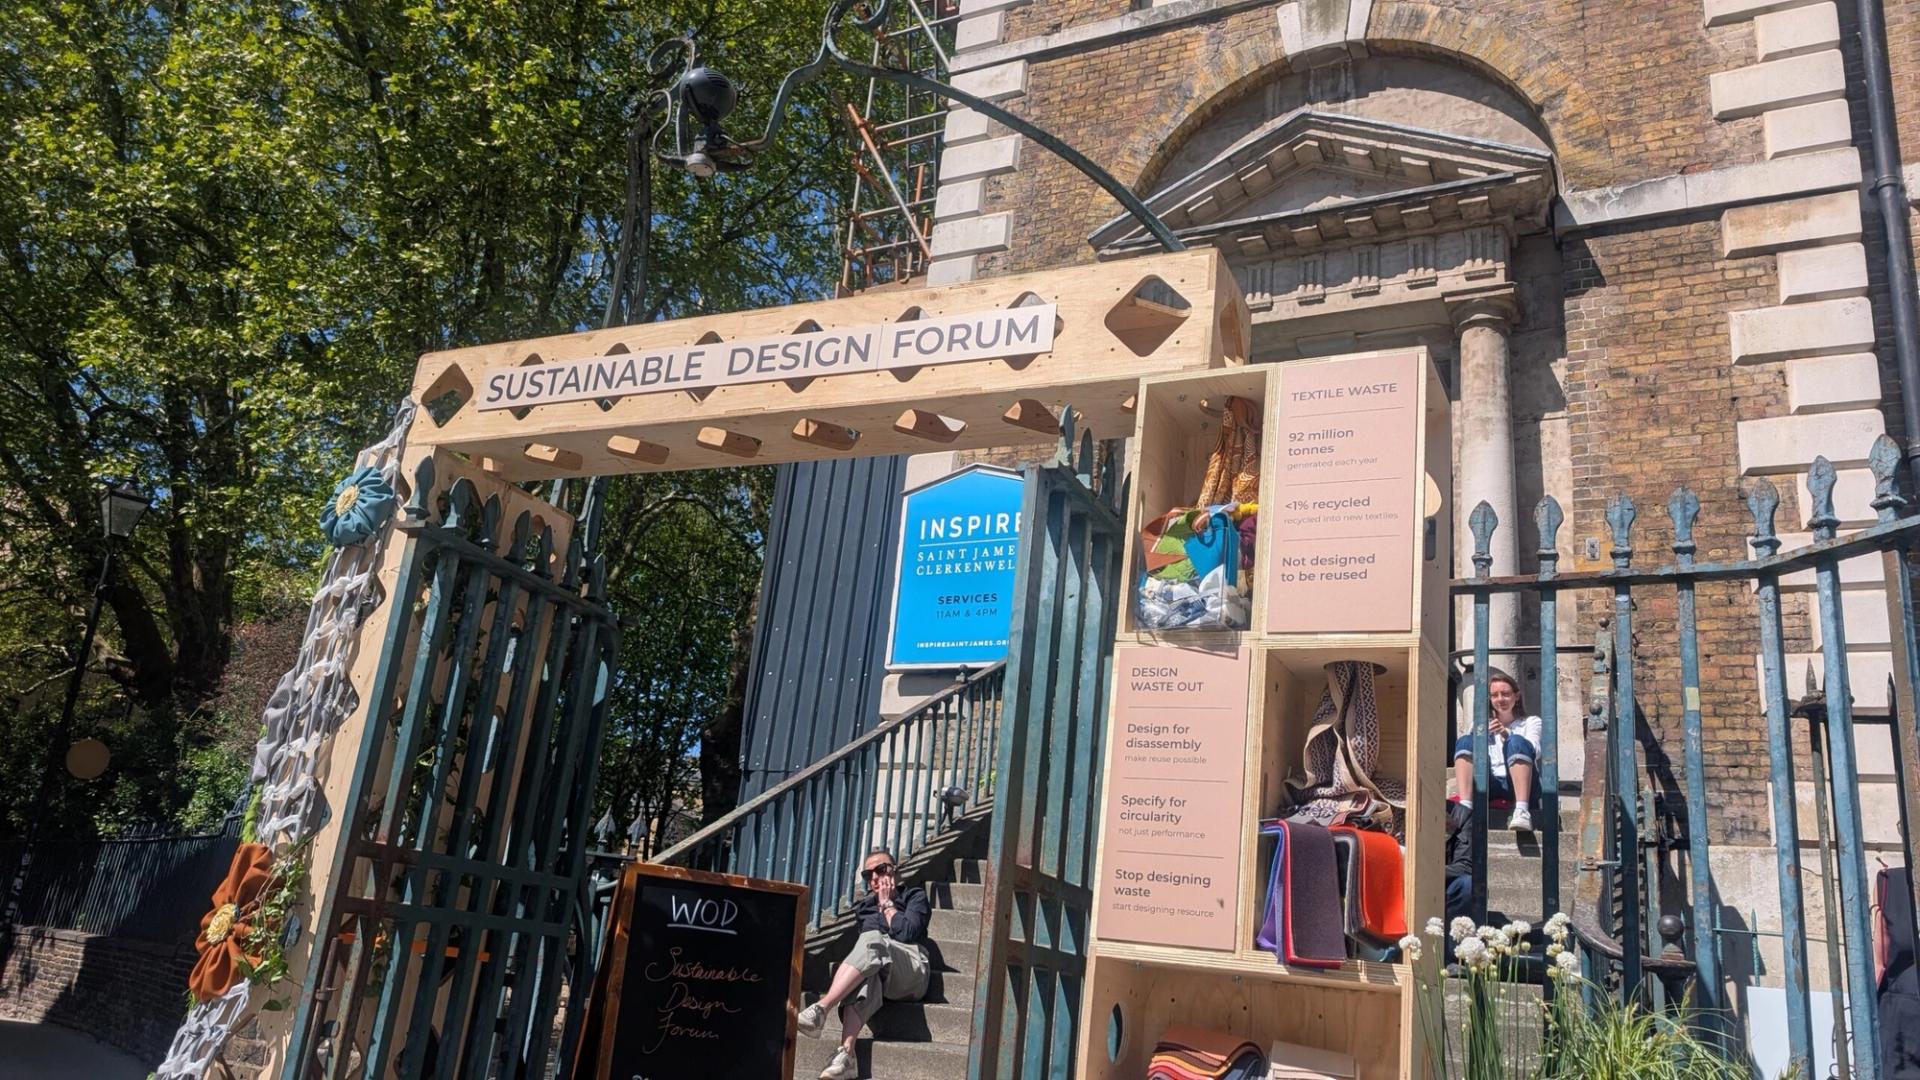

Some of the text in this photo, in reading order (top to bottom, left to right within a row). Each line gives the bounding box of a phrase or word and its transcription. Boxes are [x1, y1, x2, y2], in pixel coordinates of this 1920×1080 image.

[485, 314, 1040, 403] SUSTAINABLE DESIGN FORUM
[1292, 383, 1398, 401] TEXTILE WASTE
[1289, 428, 1354, 443] 92 million
[1288, 445, 1334, 456] tonnes
[1287, 457, 1378, 471] generated each year
[1285, 496, 1370, 511] <1% recycled
[1284, 515, 1321, 525] recycled
[1323, 514, 1341, 523] into
[1365, 512, 1398, 521] textiles
[917, 545, 1015, 562] SAINT JAME
[1282, 553, 1376, 568] Not designed
[916, 560, 1015, 576] CLERKENWEL
[1281, 569, 1368, 582] to be reused
[937, 593, 998, 605] SERVICES
[936, 609, 961, 619] 11AM
[975, 608, 998, 617] 4PM
[916, 639, 1010, 648] INSPIRESAINTJAMES.OR
[1131, 667, 1178, 677] DESIGN
[1130, 681, 1204, 692] WASTE OUT
[1127, 723, 1190, 736] Design for
[1126, 738, 1202, 751] disassembly
[1124, 754, 1147, 762] make
[1173, 755, 1207, 765] possible
[1121, 795, 1187, 808] Specify for
[1120, 810, 1182, 825] circularity
[1118, 827, 1206, 839] not just performance
[1115, 868, 1211, 888] Stop designing
[1114, 886, 1151, 897] waste
[671, 895, 738, 926] WOD
[1112, 902, 1215, 918] start designing resource
[644, 946, 764, 983] Sustainable
[656, 981, 742, 1019] Design
[641, 1010, 720, 1055] Forum
